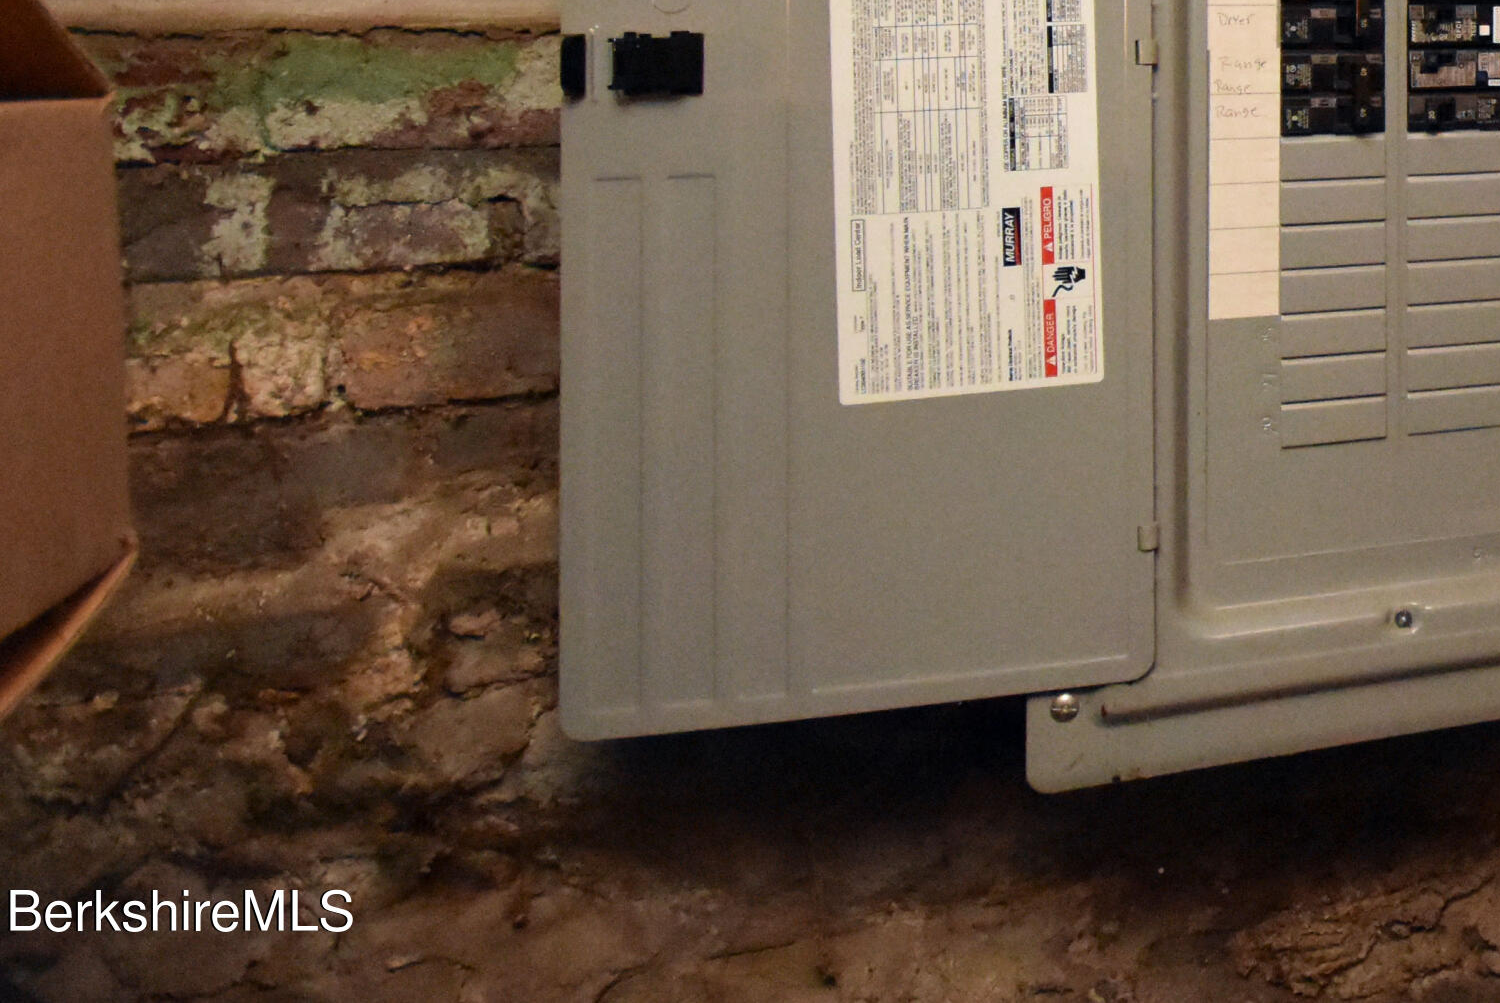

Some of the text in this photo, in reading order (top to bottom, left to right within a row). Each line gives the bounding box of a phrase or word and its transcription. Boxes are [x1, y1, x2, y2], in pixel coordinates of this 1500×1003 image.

[1004, 211, 1016, 263] MURRAY
[1042, 198, 1052, 239] PELIGRO
[1045, 312, 1055, 353] DANGER
